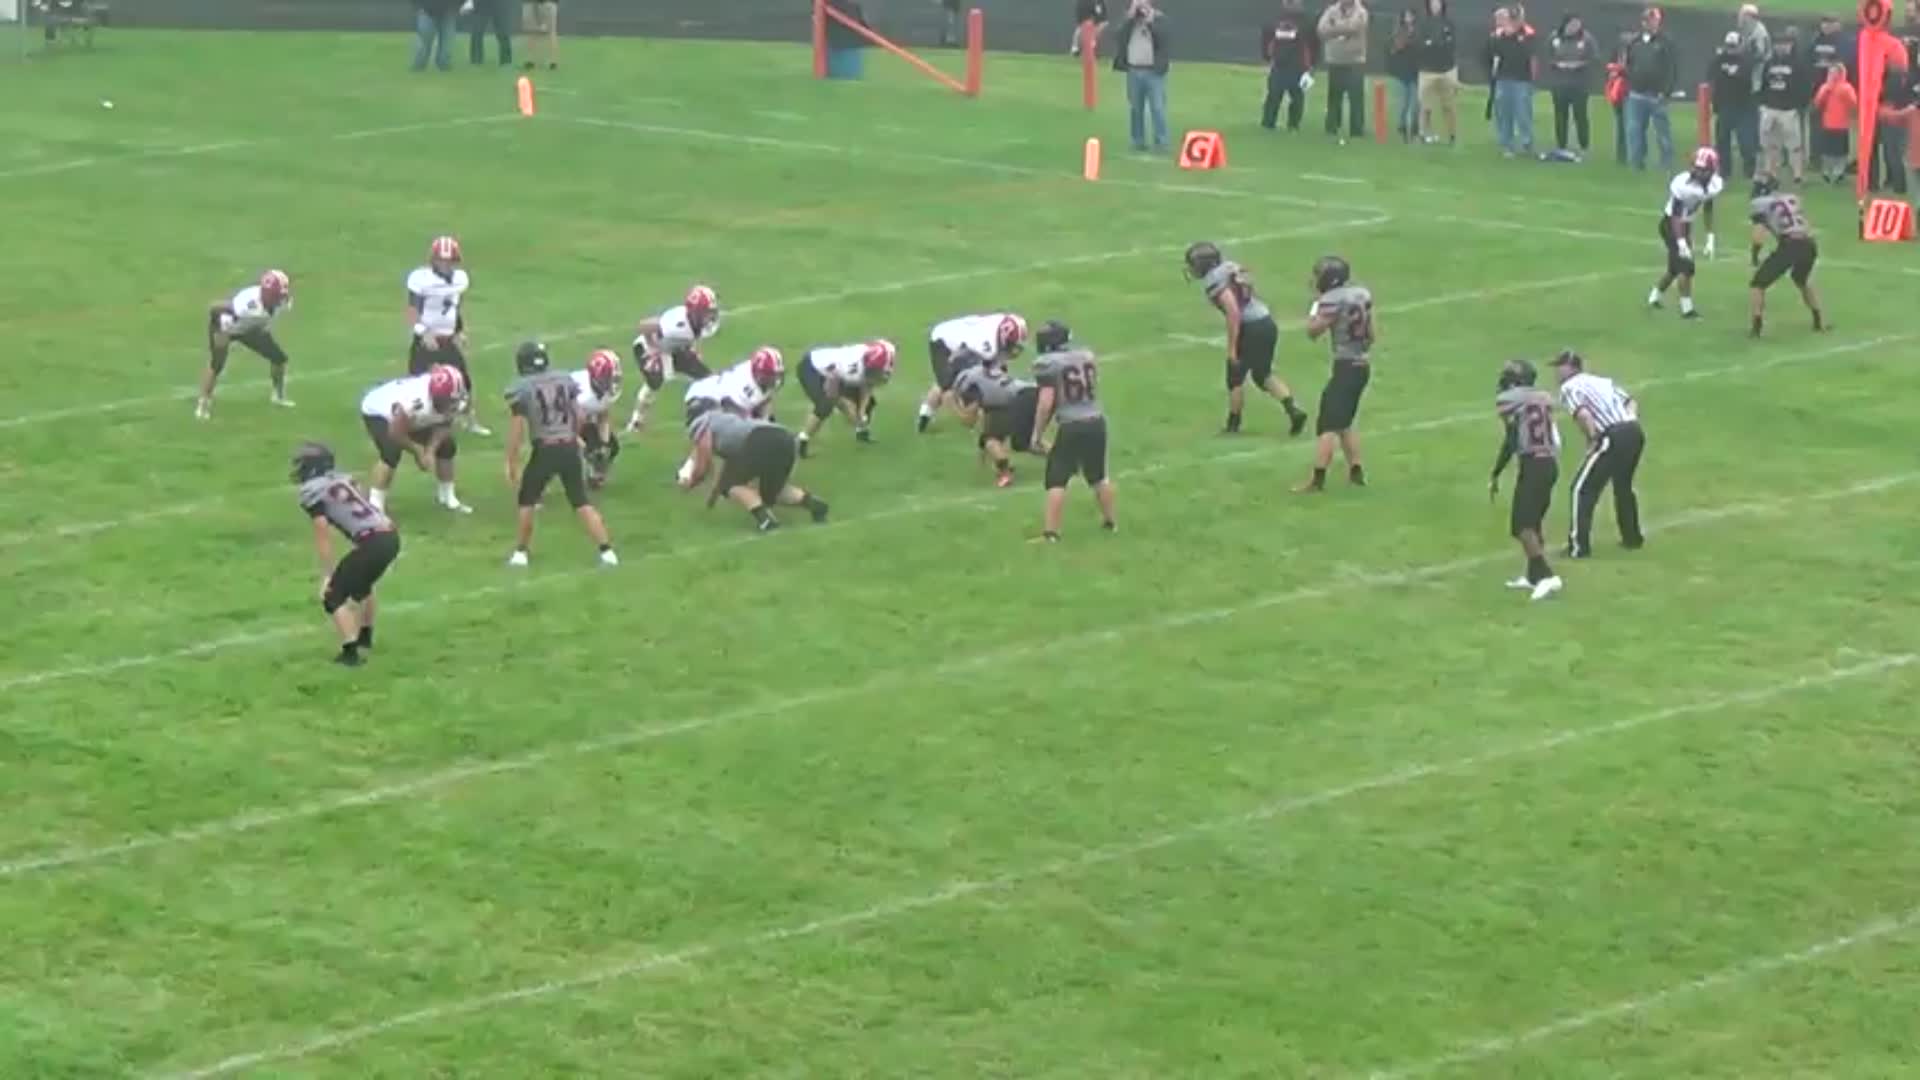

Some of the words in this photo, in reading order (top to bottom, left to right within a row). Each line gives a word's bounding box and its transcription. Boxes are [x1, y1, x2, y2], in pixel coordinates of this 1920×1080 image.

[1186, 135, 1211, 162] G
[1871, 203, 1900, 235] 10
[535, 384, 571, 424] 14
